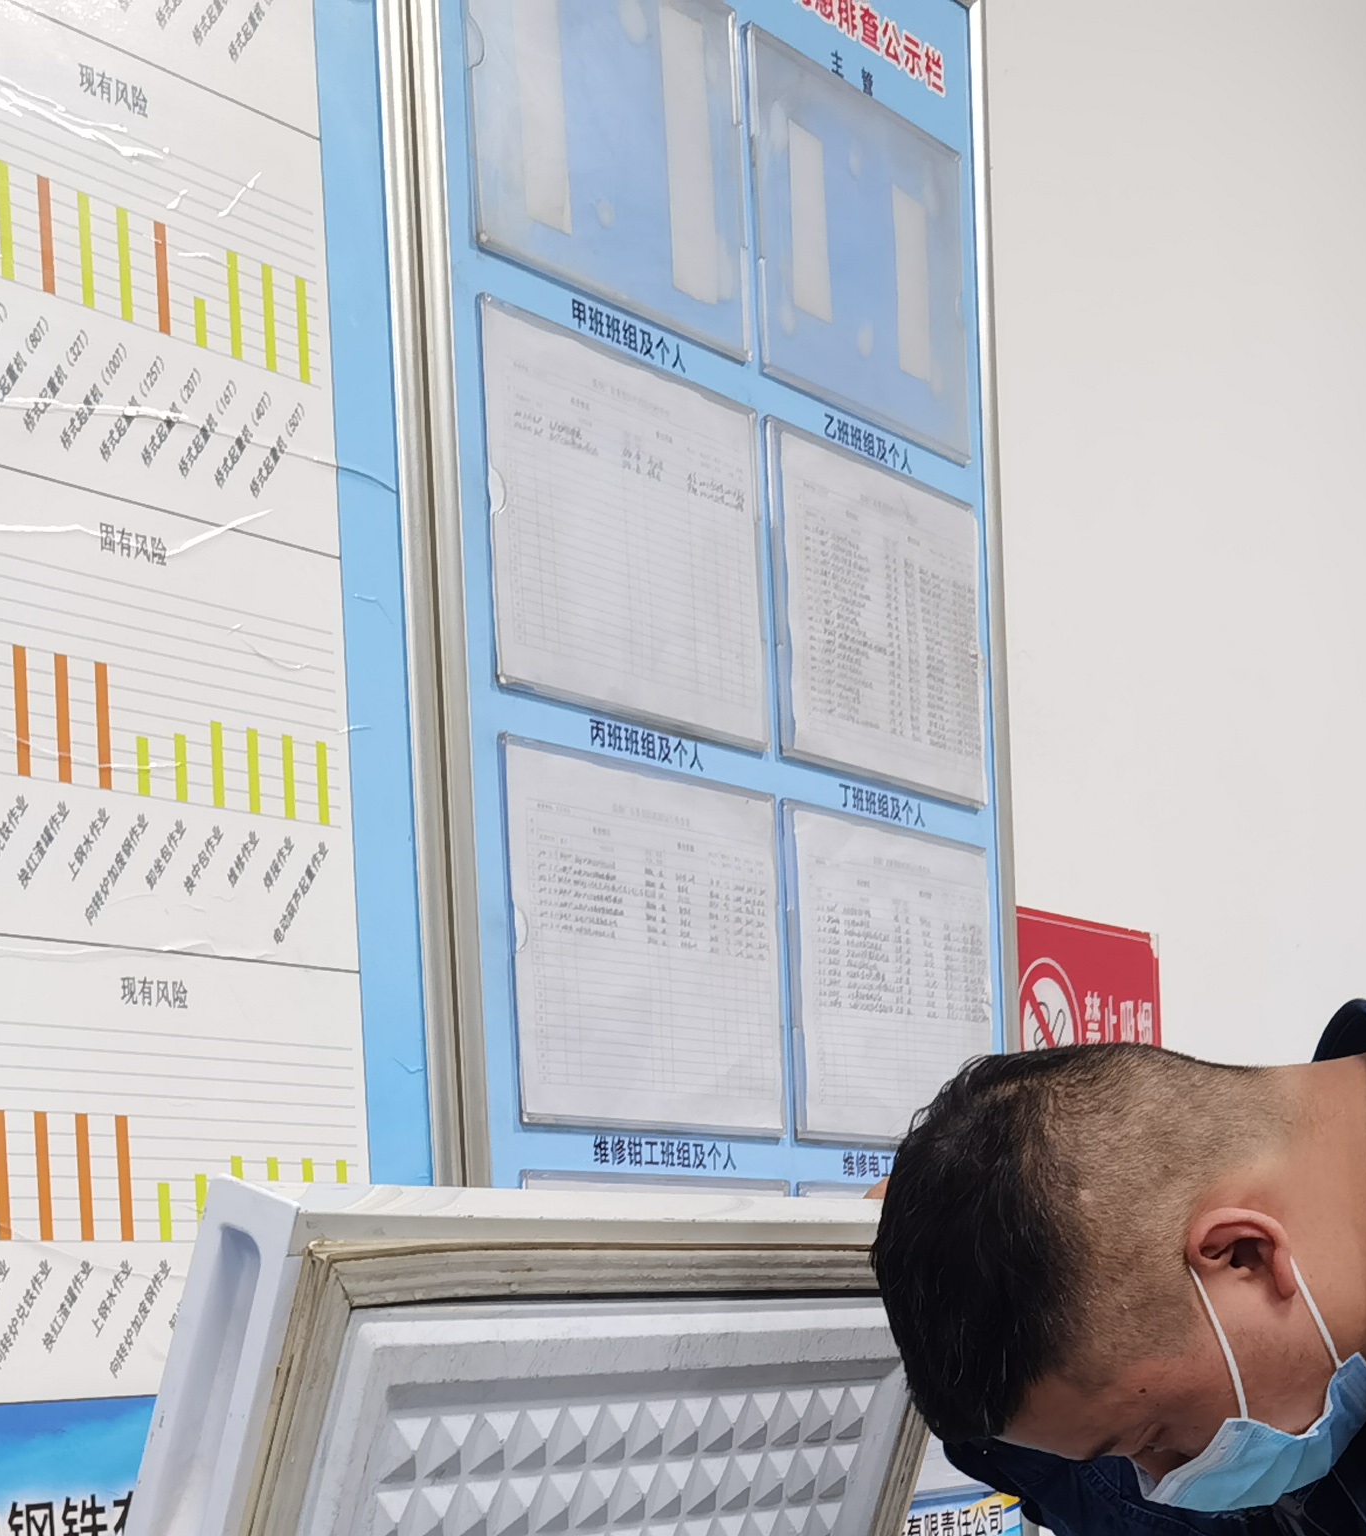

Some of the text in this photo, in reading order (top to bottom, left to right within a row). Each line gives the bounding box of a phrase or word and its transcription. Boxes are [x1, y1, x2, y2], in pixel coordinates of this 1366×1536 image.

[799, 0, 945, 94] 排查公示栏
[77, 61, 149, 120] 现有风险
[572, 298, 686, 374] 甲班班组及个人
[824, 413, 913, 474] 乙班班组及个人
[98, 520, 168, 567] 固有风险
[589, 718, 704, 772] 丙班班组及个人
[839, 783, 926, 828] 丁班班组及个人
[119, 976, 189, 1011] 现有风险
[592, 1135, 737, 1170] 维修钳工班组及个人
